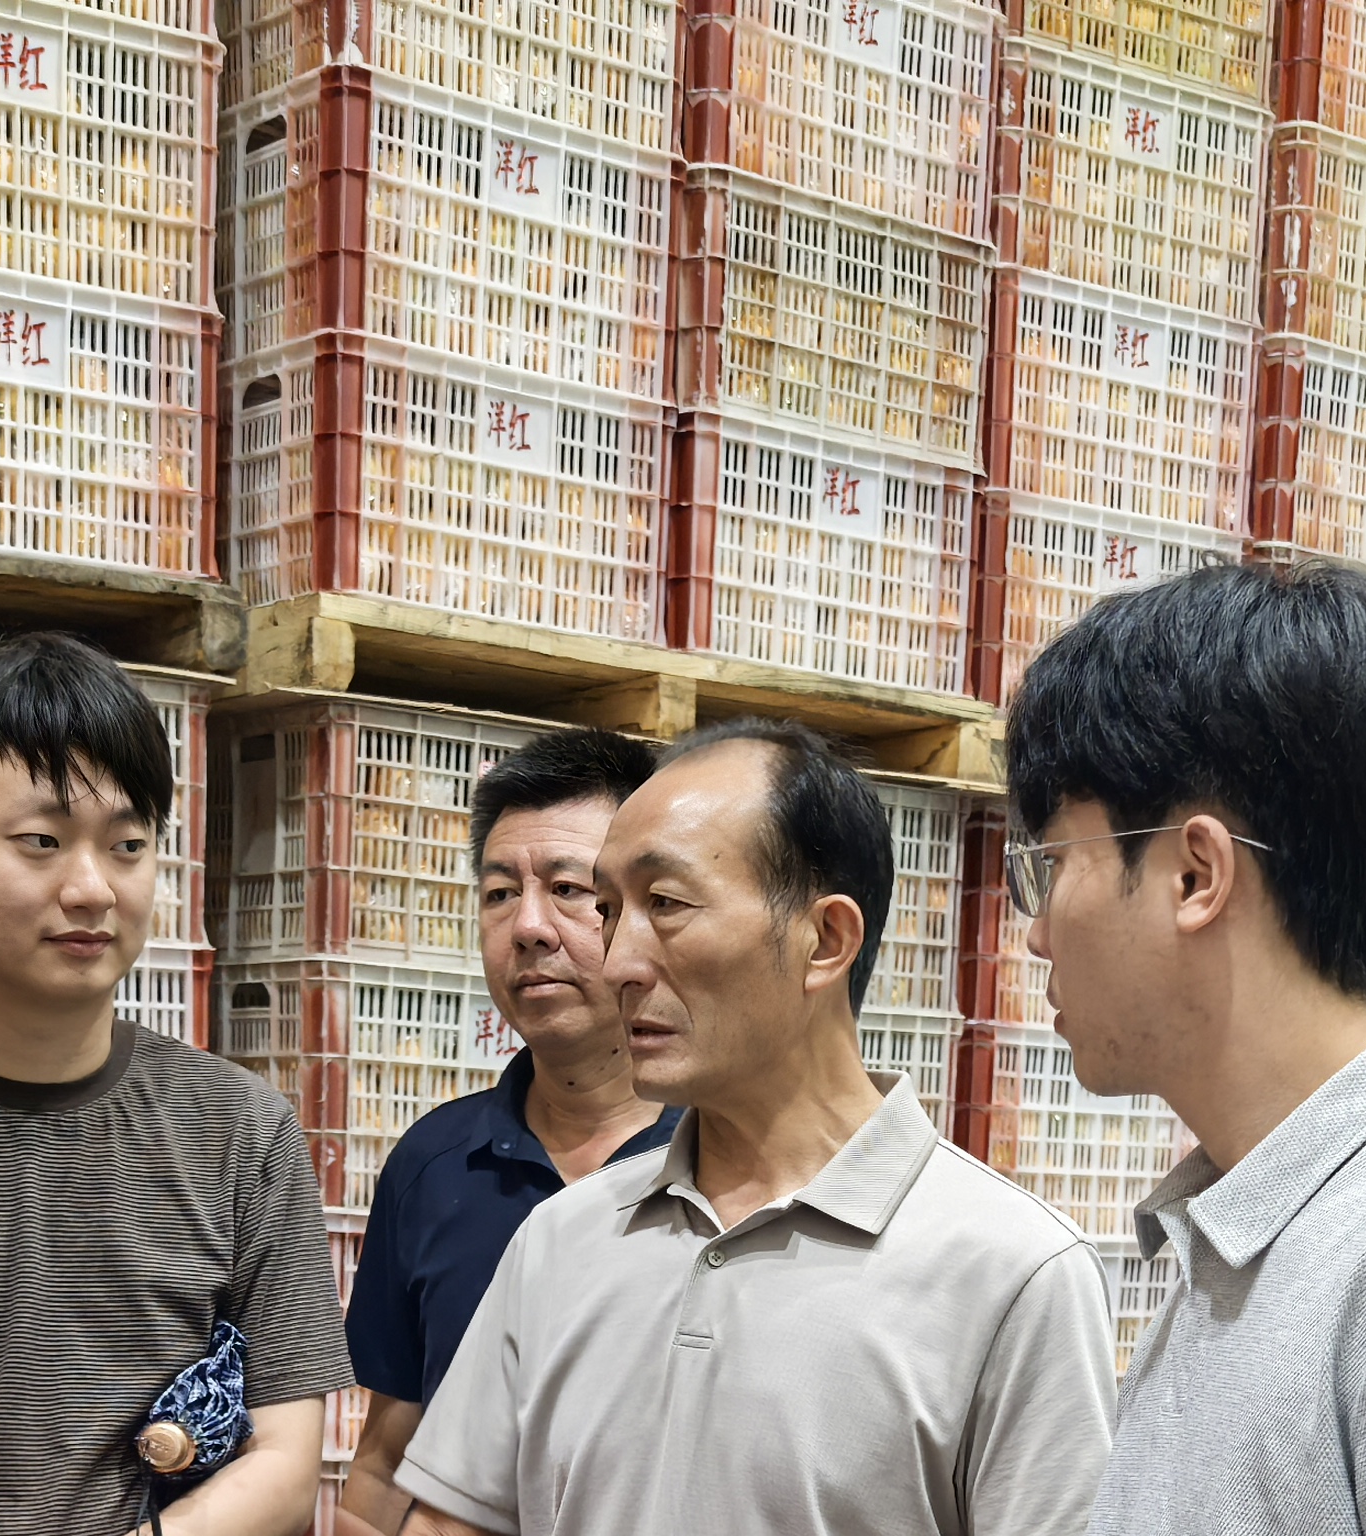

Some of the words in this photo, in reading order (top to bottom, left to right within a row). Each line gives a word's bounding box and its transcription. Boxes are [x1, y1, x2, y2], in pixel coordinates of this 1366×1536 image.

[843, 0, 879, 46] 洋红
[1125, 107, 1160, 154] 洋红
[495, 139, 540, 195] 洋红
[1114, 324, 1150, 368] 洋红
[487, 400, 532, 452] 洋红
[823, 466, 861, 516] 洋红
[1103, 535, 1138, 579] 洋红
